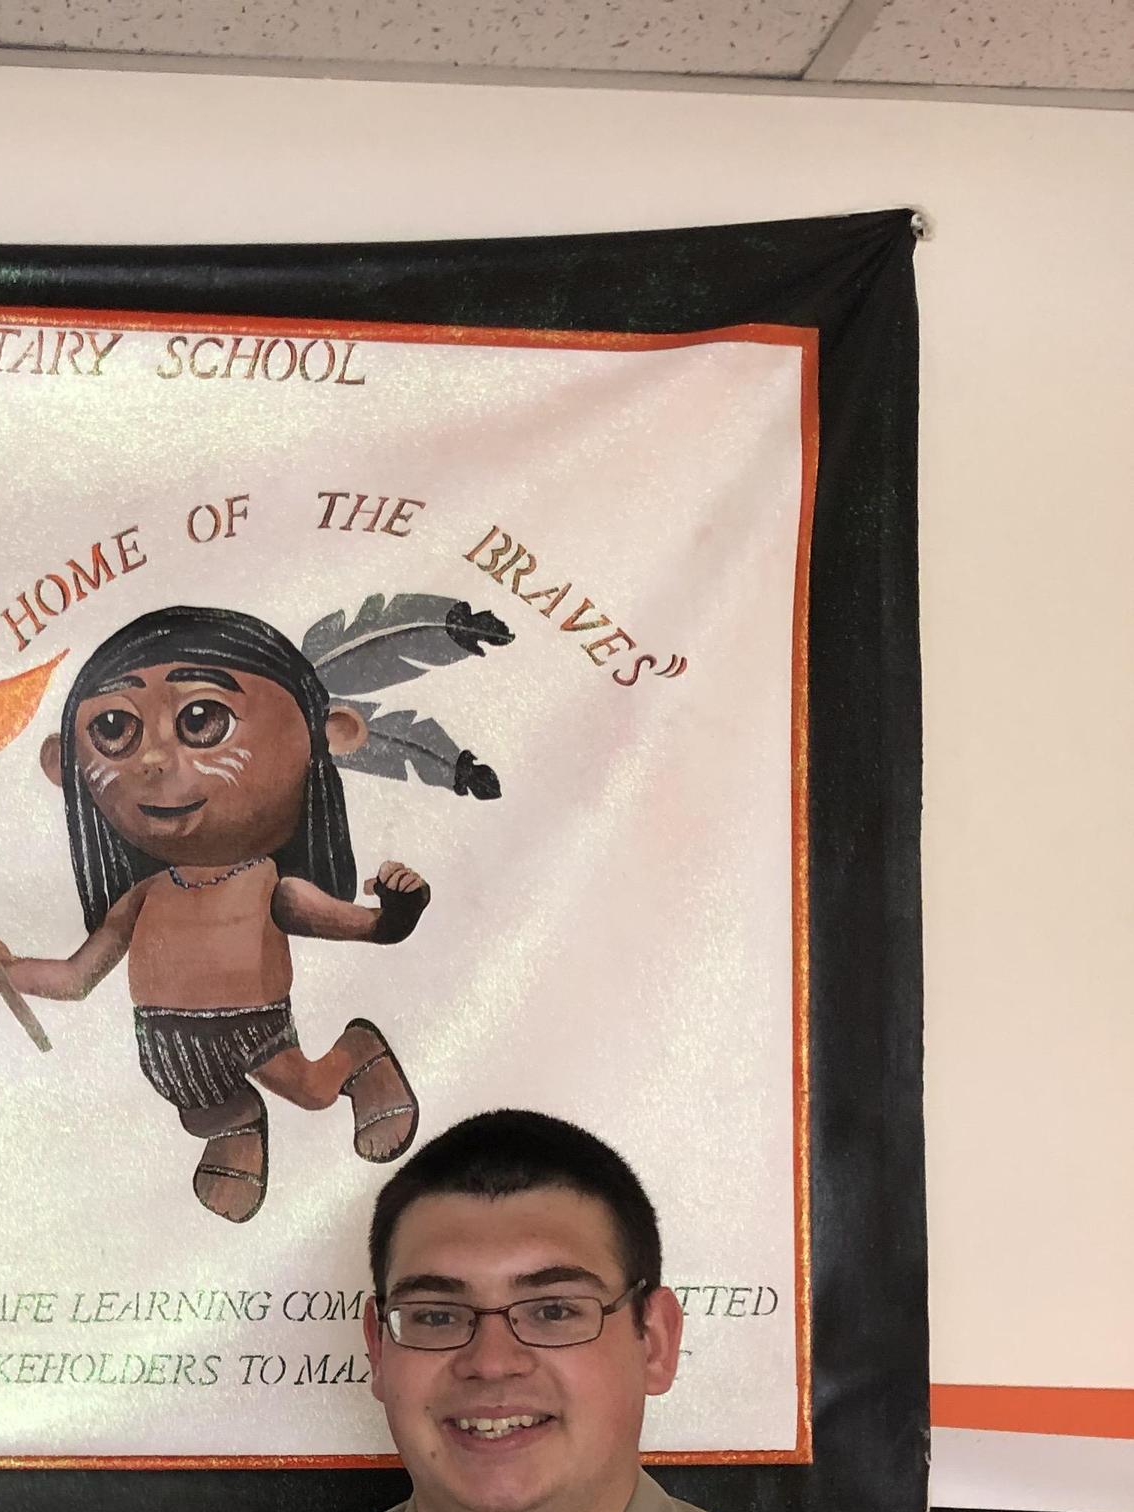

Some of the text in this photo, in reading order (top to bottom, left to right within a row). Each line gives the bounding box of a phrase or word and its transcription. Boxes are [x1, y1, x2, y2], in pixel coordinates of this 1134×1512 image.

[157, 335, 367, 386] SCHOOL
[187, 494, 251, 543] OF
[317, 492, 426, 538] THE
[69, 1289, 273, 1324] LEARNING
[282, 1289, 368, 1323] COM
[673, 1286, 779, 1318] TTED
[240, 1354, 287, 1386] TO
